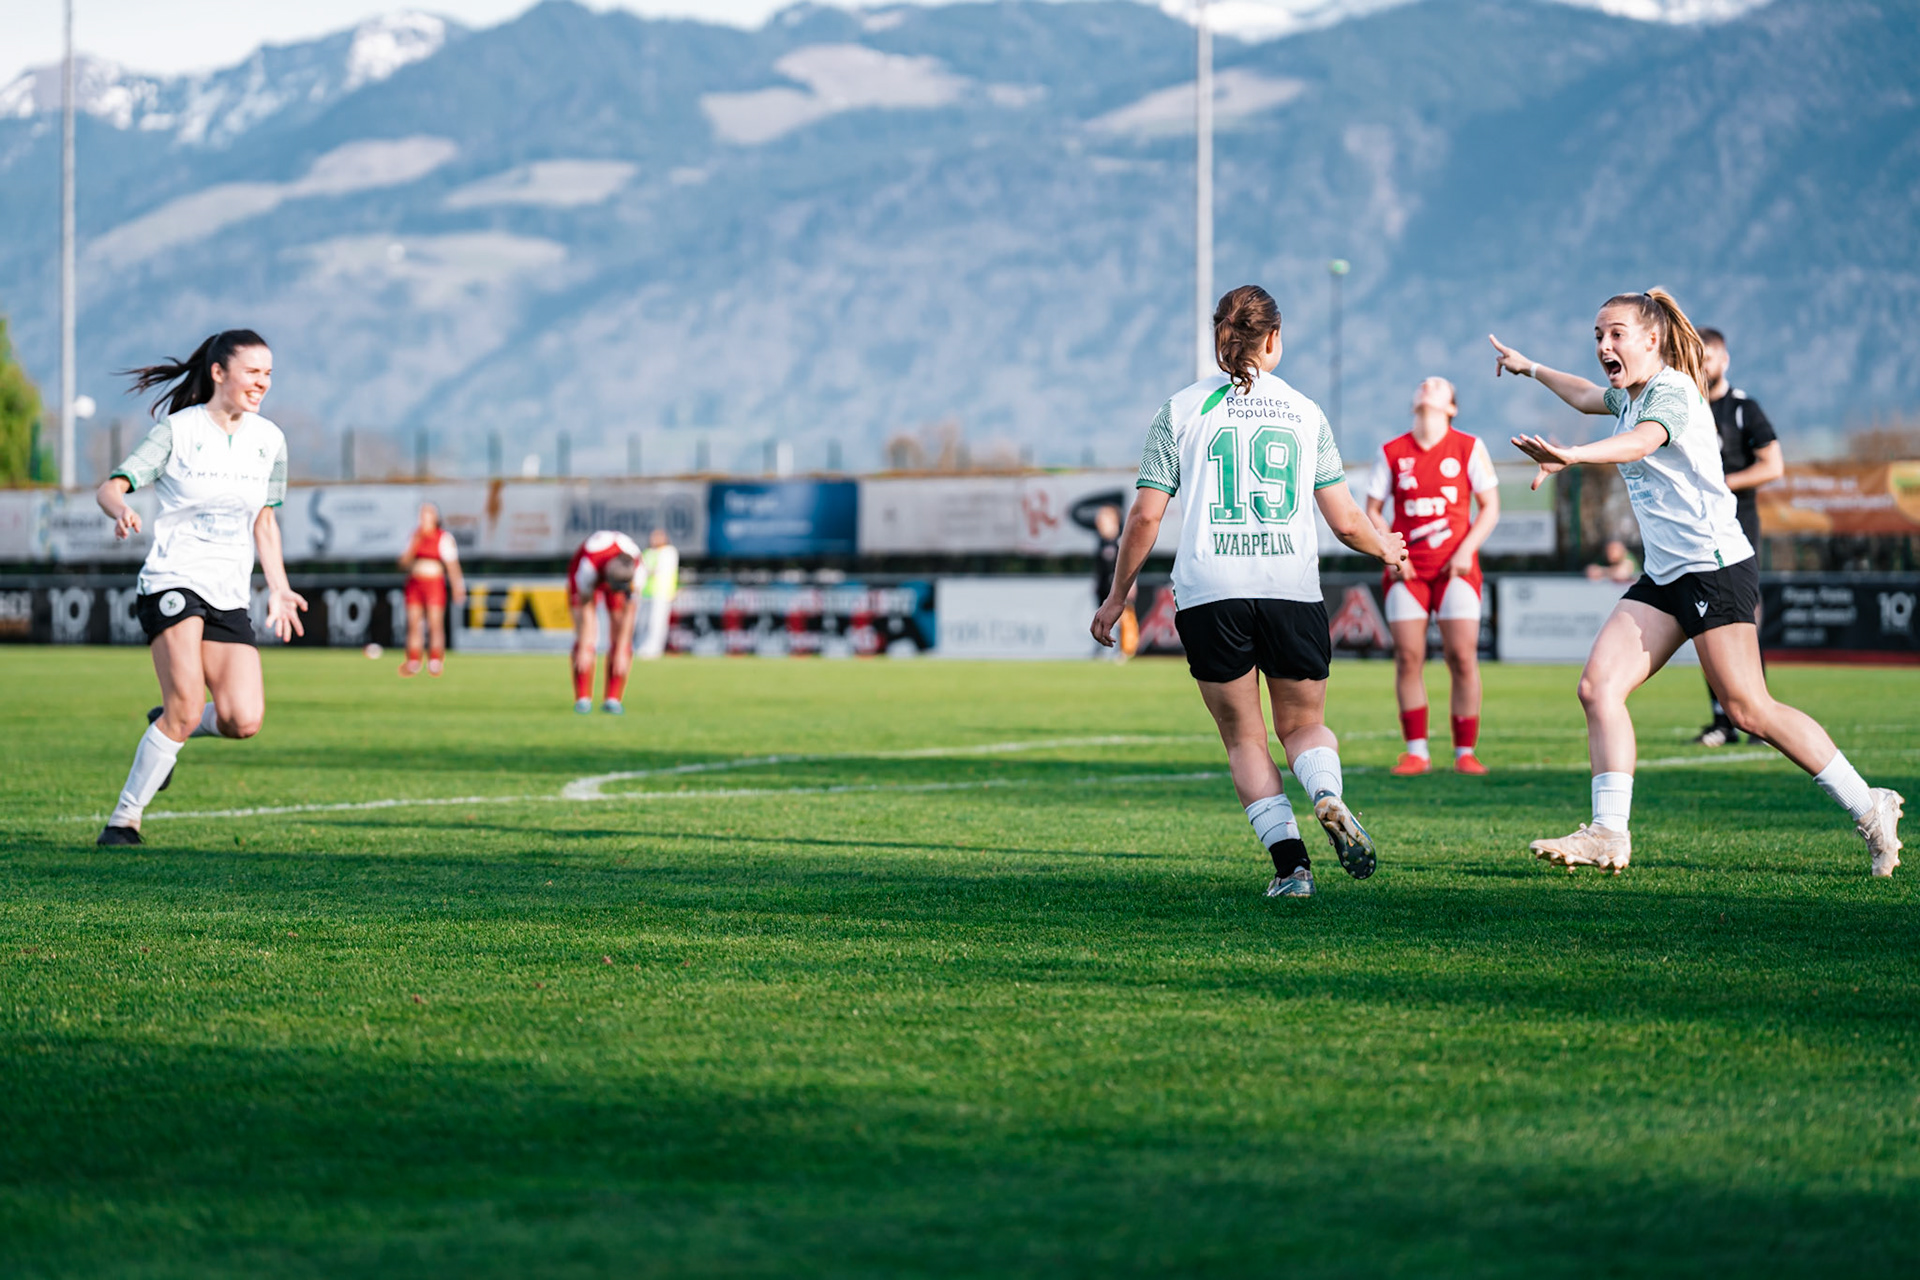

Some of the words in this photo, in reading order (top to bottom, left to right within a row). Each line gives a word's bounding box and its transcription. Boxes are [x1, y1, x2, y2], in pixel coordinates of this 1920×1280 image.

[1226, 396, 1290, 409] Retraites
[1227, 407, 1302, 423] Populaires
[1207, 425, 1302, 525] 19
[1213, 532, 1295, 556] WARPELIN
